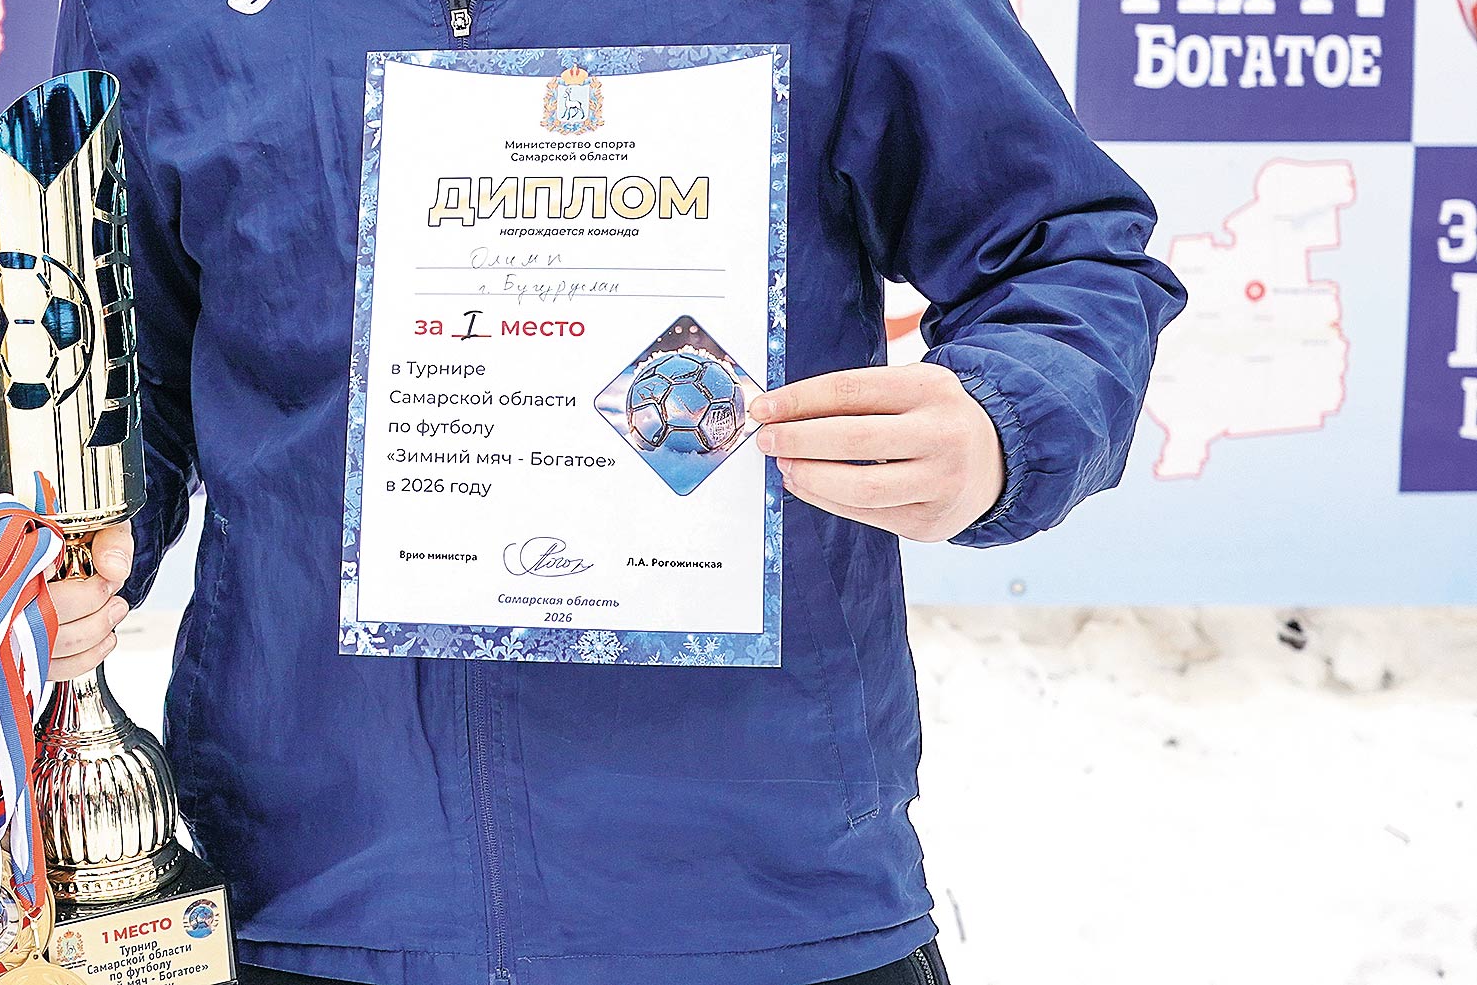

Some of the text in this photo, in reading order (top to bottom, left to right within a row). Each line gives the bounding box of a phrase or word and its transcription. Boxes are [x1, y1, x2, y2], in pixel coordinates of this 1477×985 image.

[505, 140, 636, 152] Министерство спорта
[510, 151, 628, 163] Самарской области
[428, 176, 709, 227] ДИПЛОМ
[499, 227, 640, 238] награждается команда
[414, 320, 443, 335] за
[502, 321, 585, 337] место
[392, 362, 485, 378] в Турнире
[390, 390, 575, 407] Самарской области
[389, 419, 494, 437] по футболу
[387, 449, 469, 463] «Зимний
[477, 454, 511, 464] мяч
[531, 452, 615, 467] Богатое»
[387, 478, 491, 497] в 2026 году
[400, 550, 477, 563] Врио министра
[627, 558, 722, 568] Л.А. Рогожинская
[498, 594, 619, 607] Самарская область
[544, 613, 572, 622] 2026
[101, 917, 172, 944] 1 МЕСТО
[118, 939, 158, 958] Турнир
[87, 954, 146, 975] Самарской
[147, 943, 193, 962] области
[109, 960, 173, 982] по футболу
[158, 963, 210, 982] Богатое»
